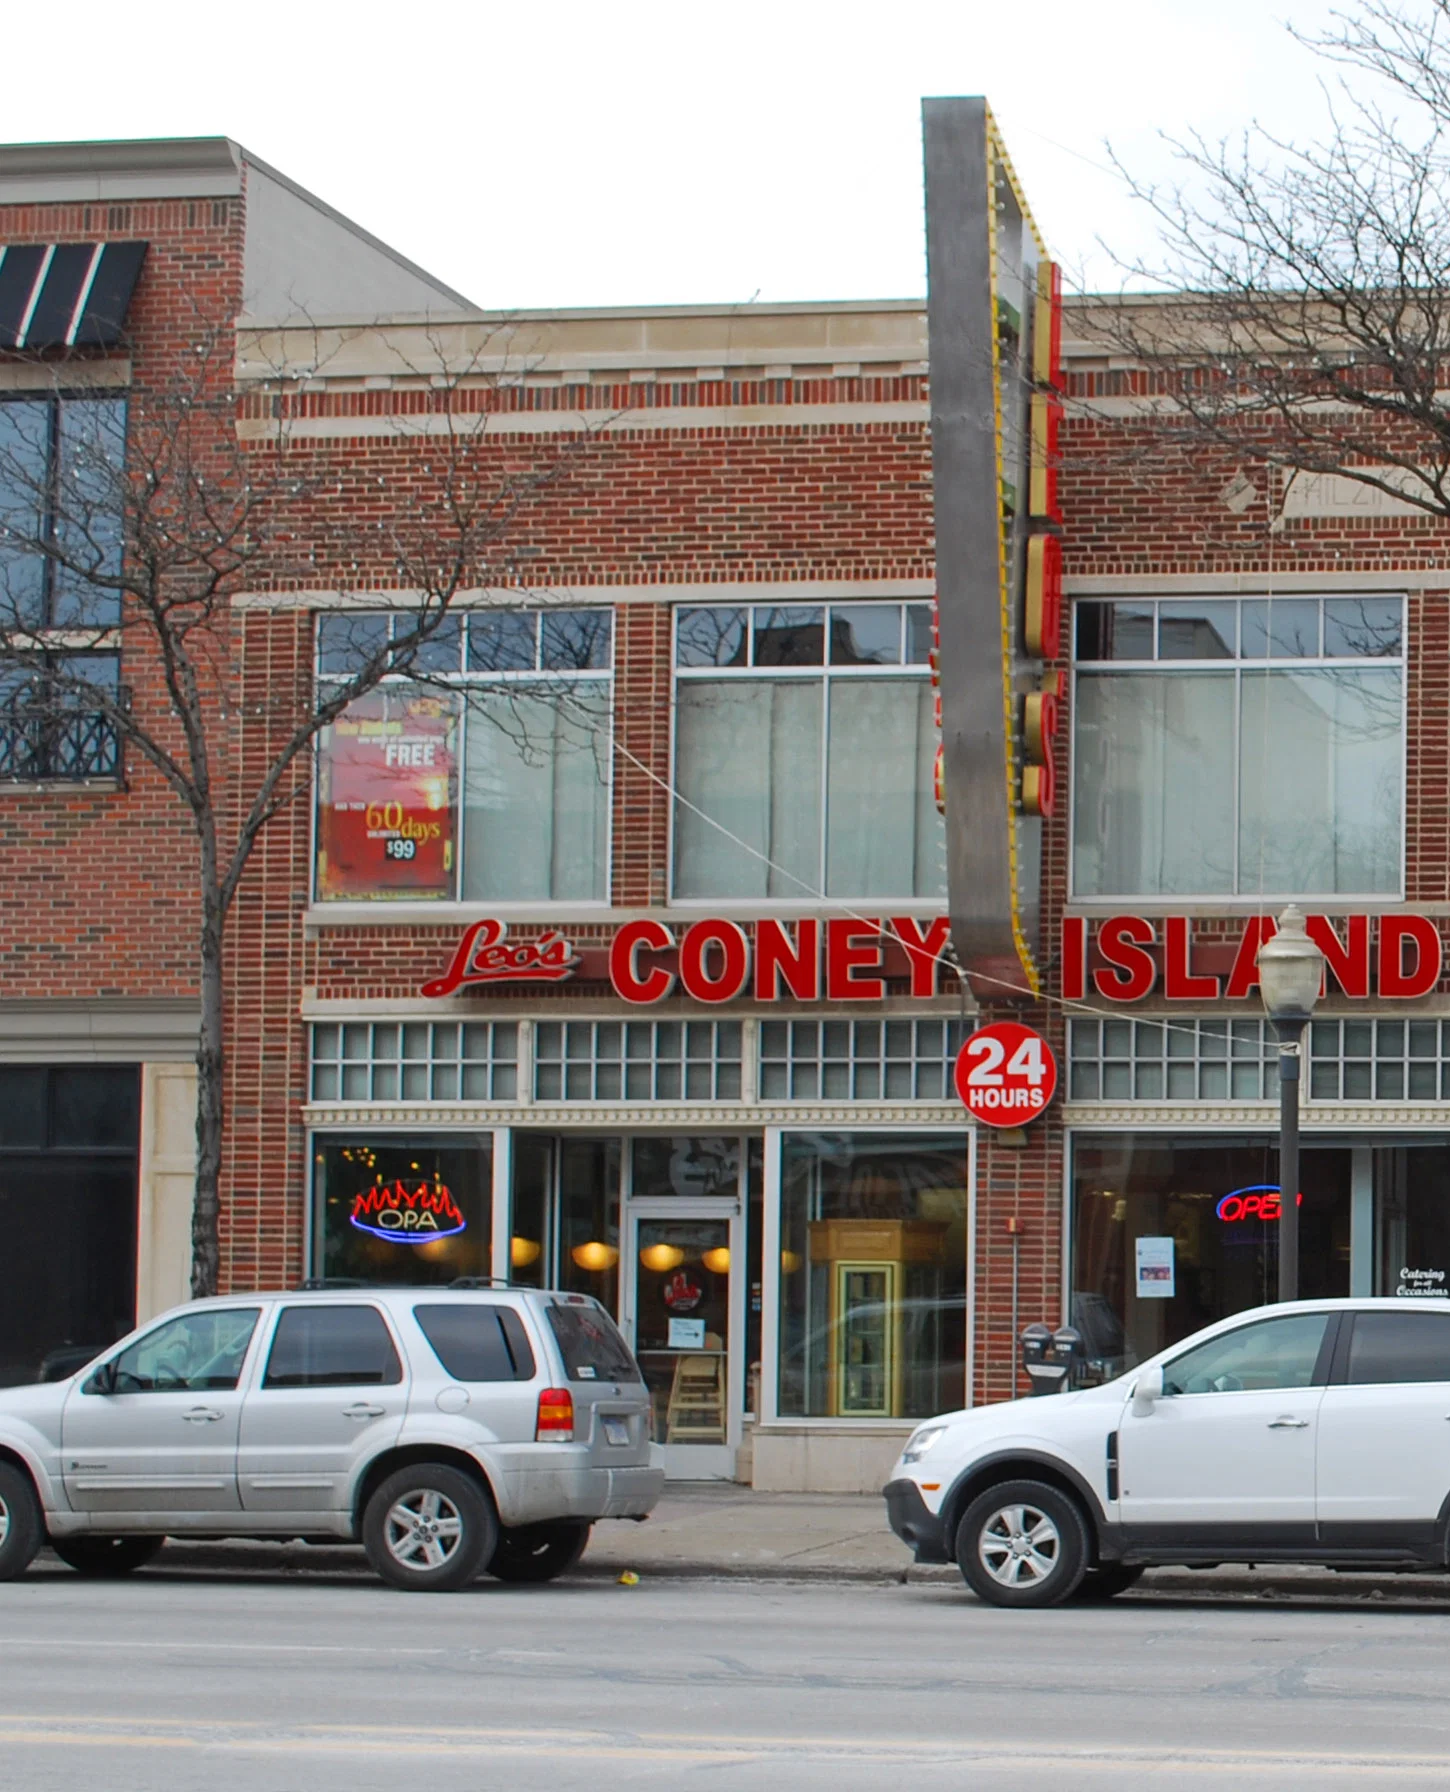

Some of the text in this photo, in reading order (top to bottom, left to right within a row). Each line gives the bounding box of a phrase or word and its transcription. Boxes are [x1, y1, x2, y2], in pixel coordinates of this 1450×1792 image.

[386, 743, 435, 767] FREE
[366, 800, 441, 848] 60 days
[387, 839, 416, 860] $99
[420, 918, 580, 998] Leo's
[609, 914, 1443, 1003] CONEY ISLAND
[966, 1036, 1047, 1086] 24
[969, 1086, 1044, 1110] HOURS
[377, 1208, 439, 1230] OPA
[1399, 1266, 1445, 1282] Catering
[1396, 1284, 1449, 1297] Occasions
